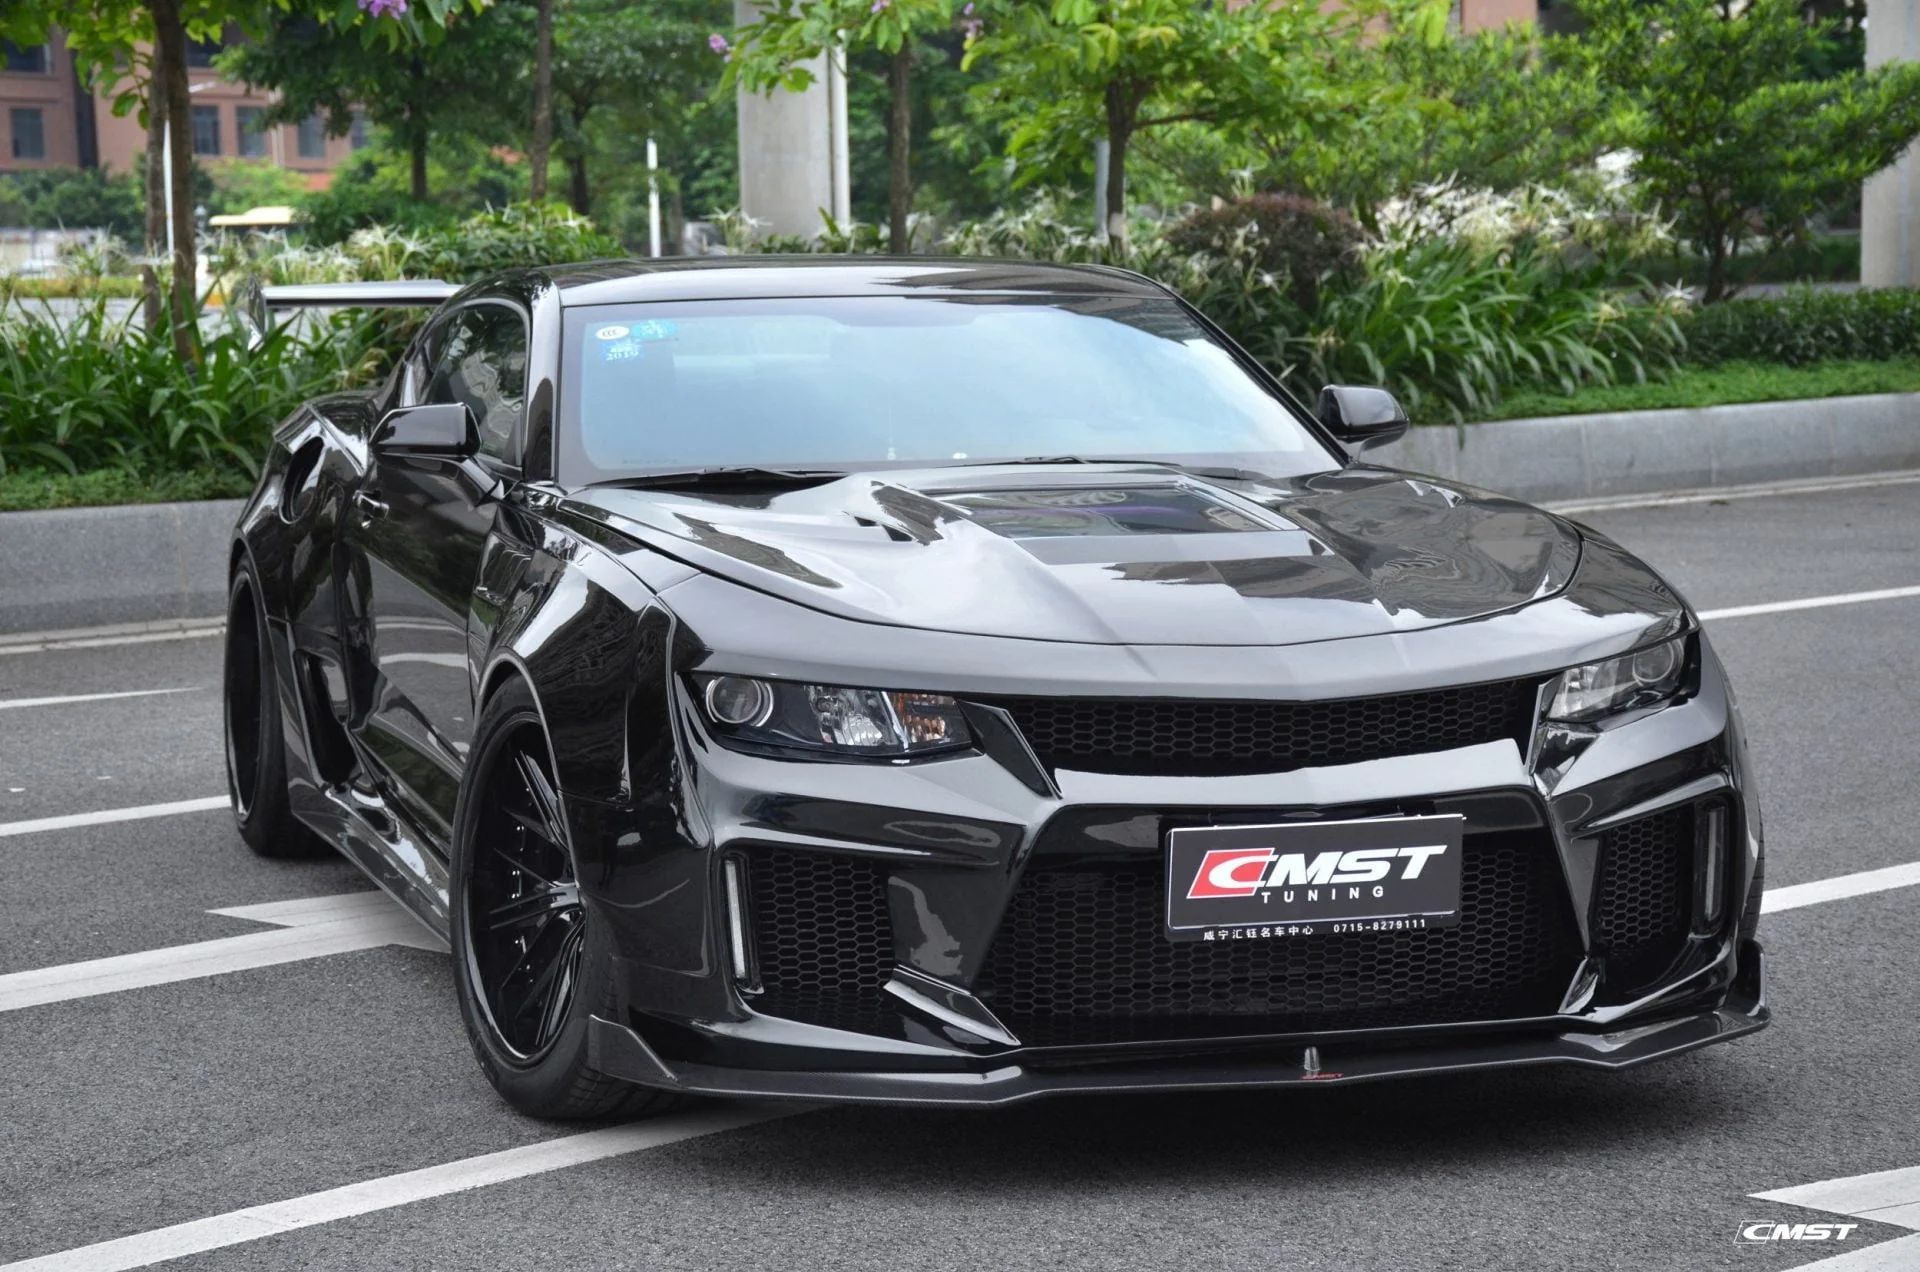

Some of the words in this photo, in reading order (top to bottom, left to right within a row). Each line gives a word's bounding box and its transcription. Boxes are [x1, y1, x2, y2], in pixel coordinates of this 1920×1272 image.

[1207, 845, 1448, 889] CMST
[1261, 885, 1384, 904] TUNING
[1333, 919, 1426, 933] 0715-8279111
